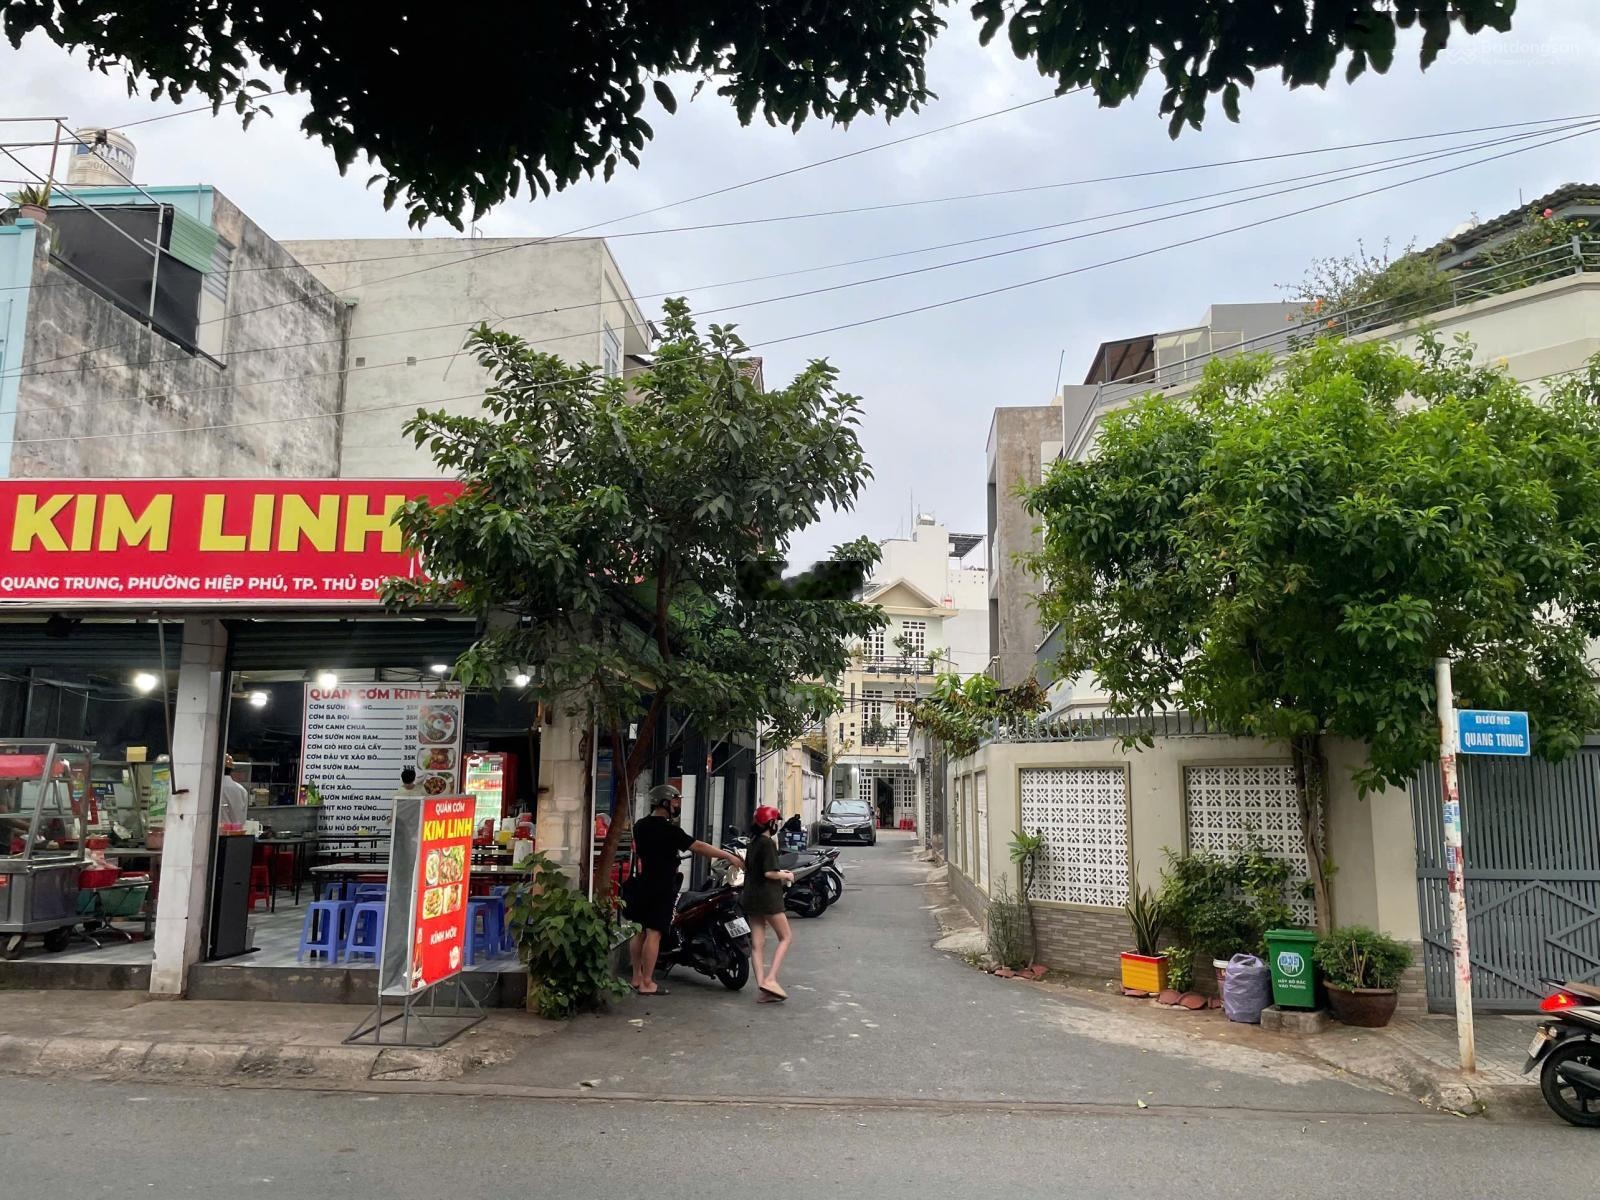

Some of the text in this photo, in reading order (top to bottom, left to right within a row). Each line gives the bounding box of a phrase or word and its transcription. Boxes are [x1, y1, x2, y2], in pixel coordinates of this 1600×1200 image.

[11, 494, 406, 552] KIM LINH
[1, 573, 390, 592] QUANG TRUNG, PHƯỜNG HIỆP PHÚ, TP. THỦ ĐỨ
[358, 687, 390, 700] CƠM
[394, 688, 421, 700] KIM
[1475, 713, 1511, 725] ĐƯỜNG
[1464, 732, 1524, 747] QUANG TRUNG
[435, 800, 465, 816] QUÁN CƠM
[423, 817, 473, 841] KIM LINH
